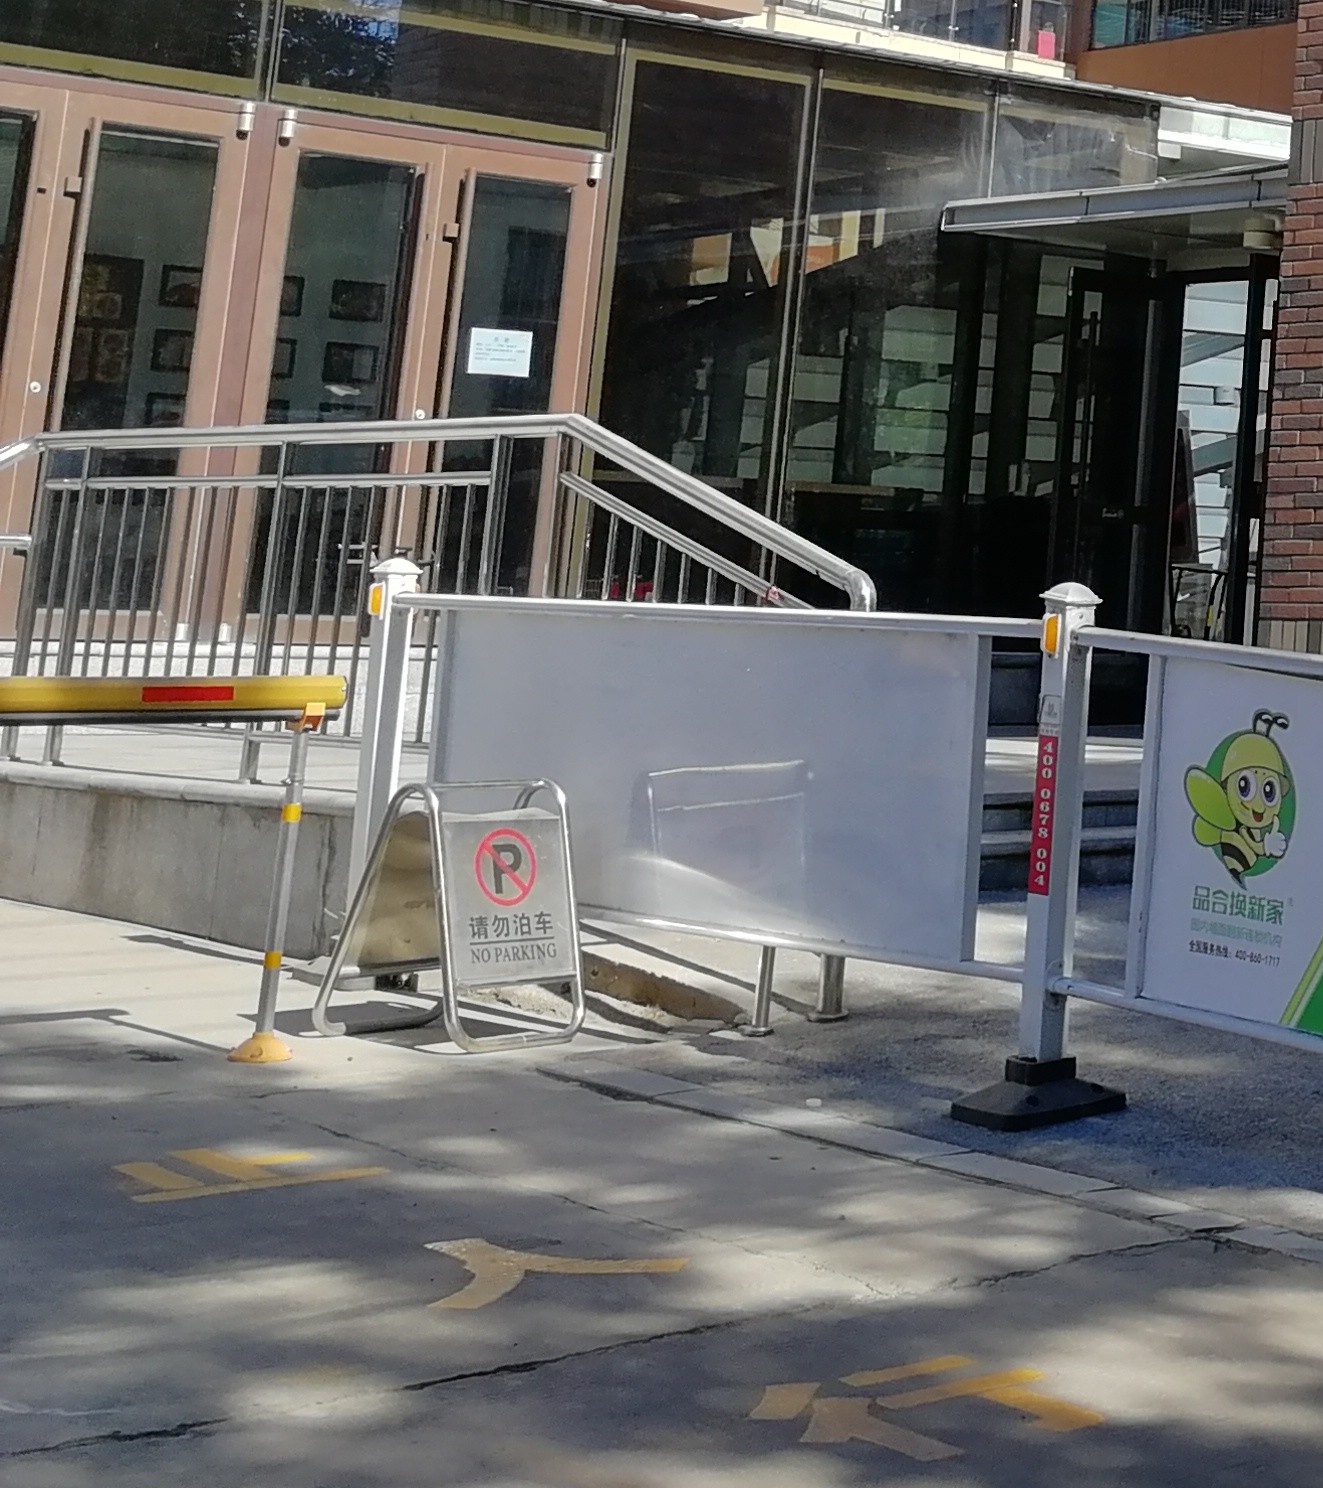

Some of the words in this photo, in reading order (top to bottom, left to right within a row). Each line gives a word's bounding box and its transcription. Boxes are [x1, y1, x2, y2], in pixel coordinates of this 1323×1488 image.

[1041, 741, 1054, 780] 400
[1037, 787, 1052, 839] 0678
[1033, 848, 1048, 886] 004
[1192, 885, 1285, 926] 品合换新家
[469, 911, 554, 940] 请勿泊车
[470, 948, 491, 964] NO
[495, 943, 557, 964] PARKING
